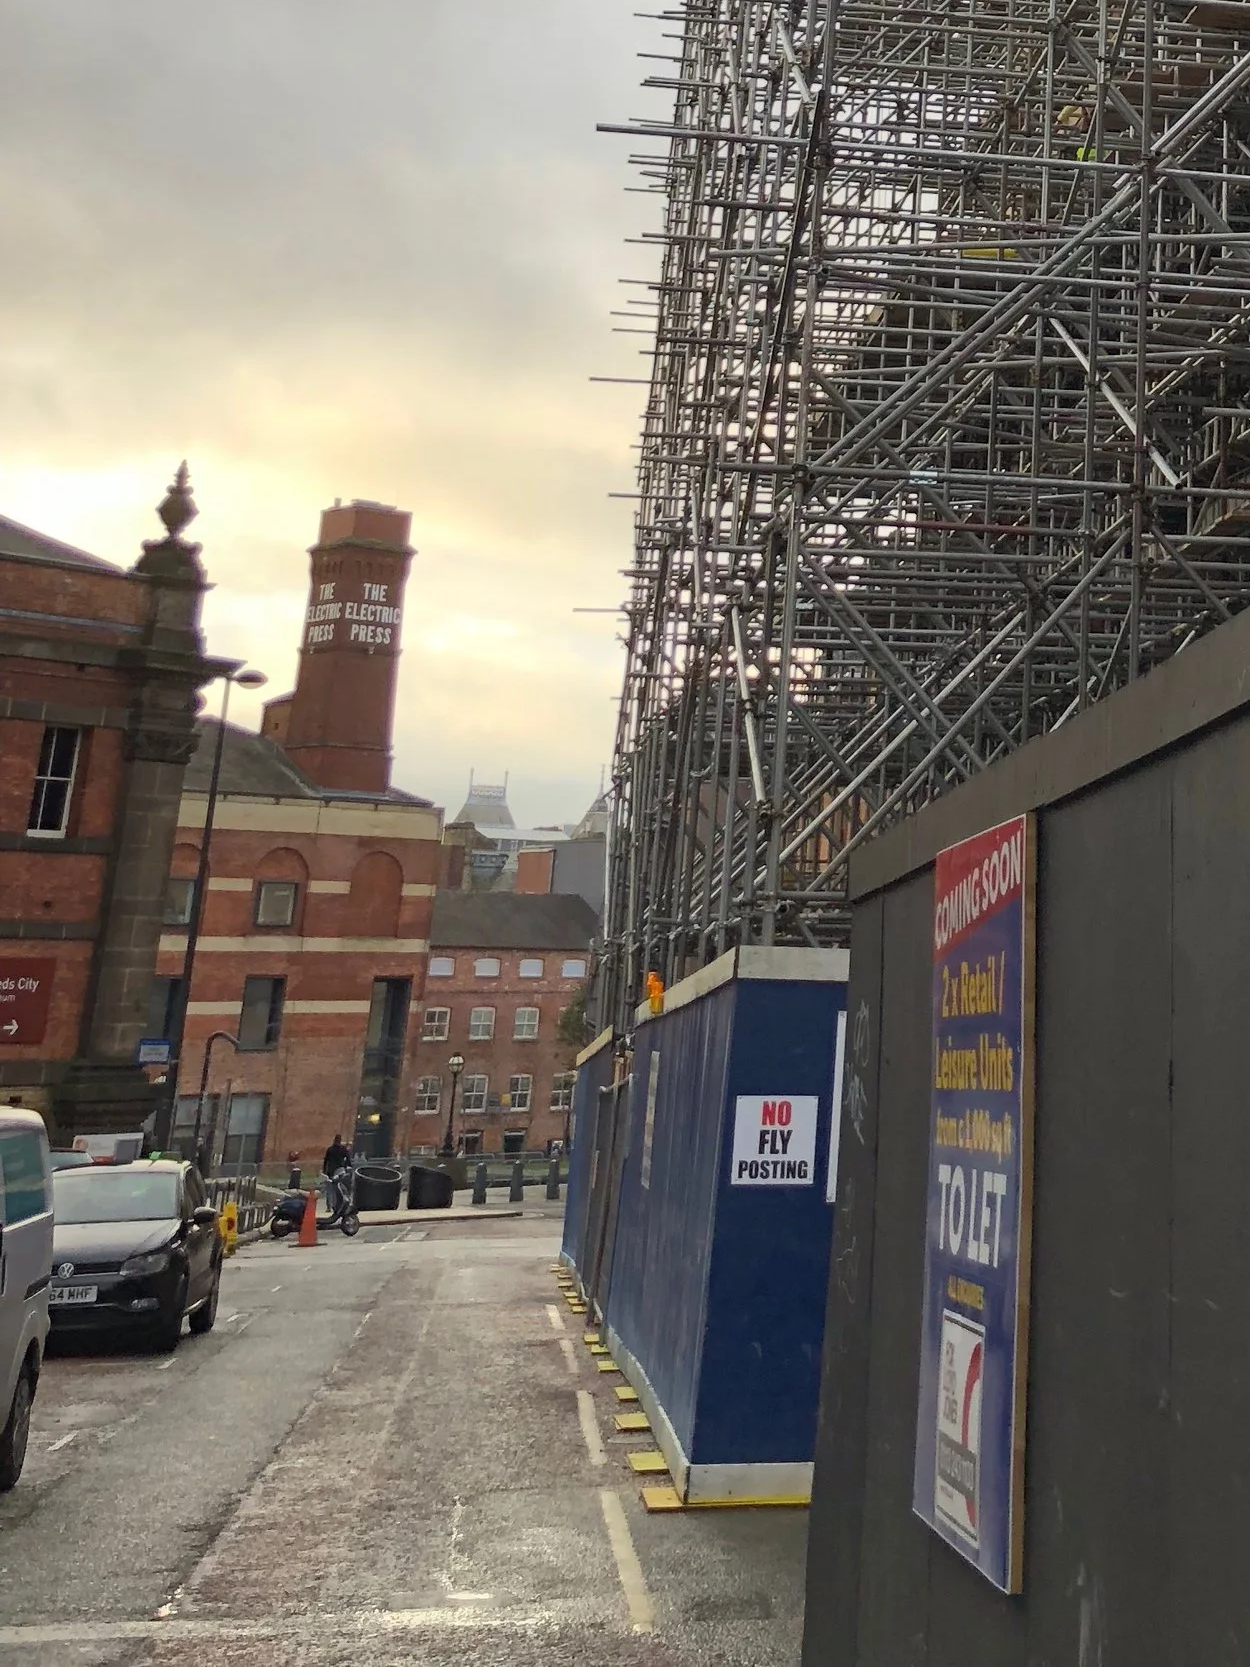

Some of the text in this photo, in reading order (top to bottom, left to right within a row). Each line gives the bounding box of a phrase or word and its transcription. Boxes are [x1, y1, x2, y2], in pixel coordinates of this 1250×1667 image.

[319, 582, 336, 601] THE
[363, 582, 388, 602] THE
[306, 602, 342, 623] ELECTRIC
[345, 602, 401, 625] ELECTRIC
[308, 624, 335, 643] PRESS
[350, 624, 392, 645] PRESS
[935, 830, 1021, 951] COMING SOON
[17, 977, 40, 993] City
[942, 965, 950, 1018] 2
[951, 977, 959, 1016] x
[961, 955, 997, 1015] Retail
[936, 1032, 1013, 1092] Leisure Units
[761, 1100, 792, 1126] NO
[758, 1129, 793, 1155] FLY
[738, 1160, 809, 1180] POSTING
[938, 1163, 1007, 1268] TO LET
